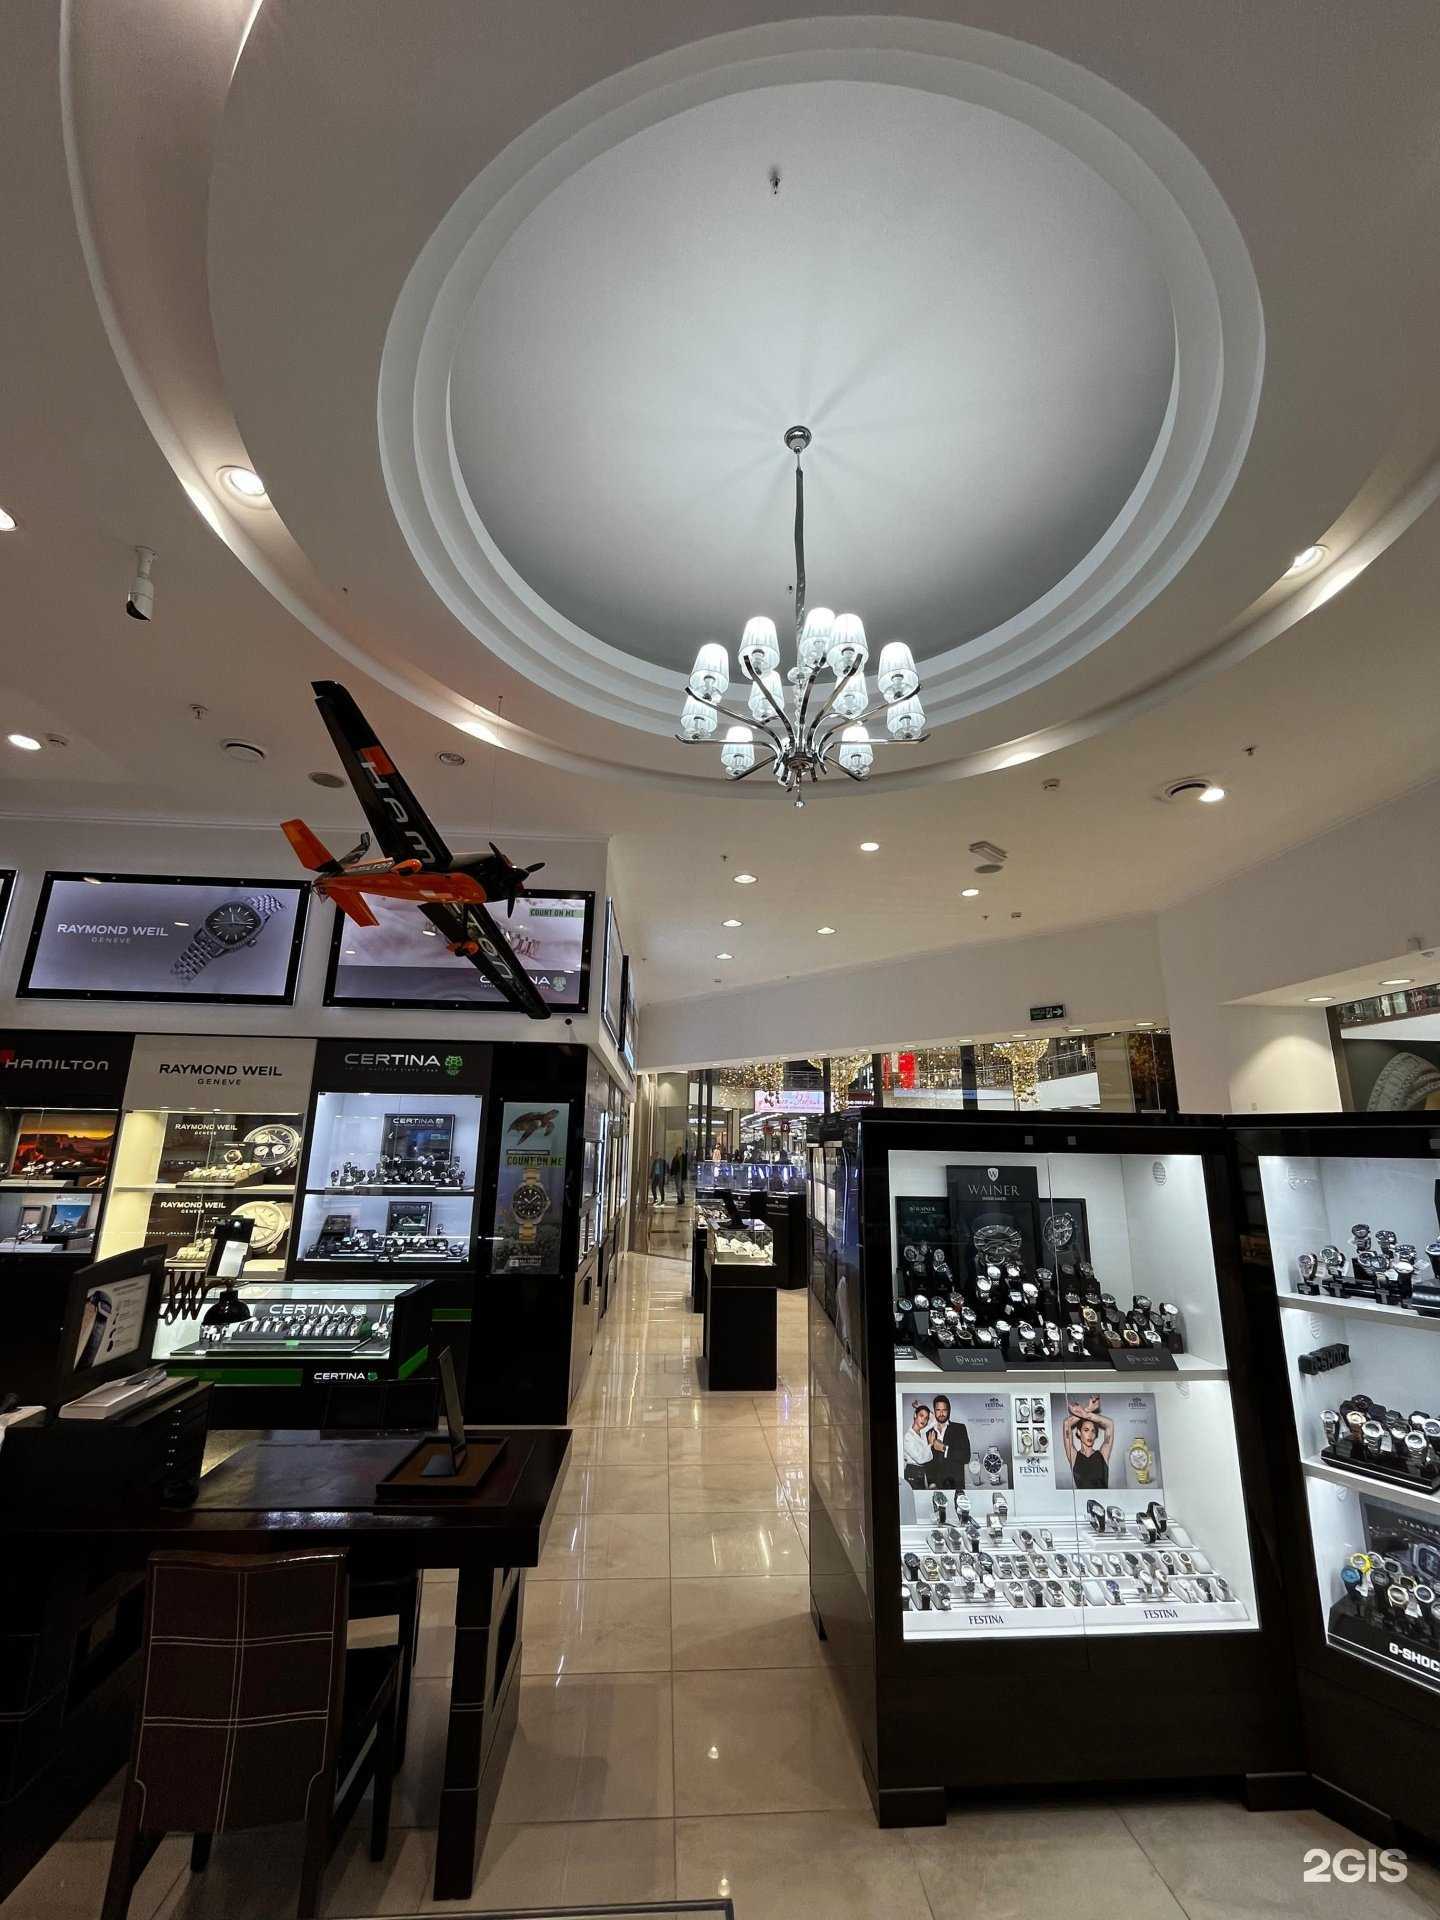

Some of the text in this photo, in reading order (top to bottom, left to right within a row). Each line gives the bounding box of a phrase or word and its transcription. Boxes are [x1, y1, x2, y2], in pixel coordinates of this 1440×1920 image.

[554, 909, 564, 917] ON
[57, 923, 169, 937] RAYMOND WEIL
[4, 1058, 110, 1071] HAMILTON
[344, 1053, 441, 1067] CERTINA
[159, 1063, 283, 1077] RAYMOND WEIL
[197, 1078, 242, 1086] GENEVE
[175, 1123, 215, 1131] RAYMOND
[507, 1156, 537, 1167] COUNT
[551, 1157, 563, 1167] ME
[968, 1184, 1020, 1196] WAINER
[160, 1201, 202, 1209] RAYMOND
[269, 1304, 348, 1315] CERTINA
[313, 1372, 366, 1381] CERTINA
[1019, 1466, 1049, 1474] FESTINA
[1144, 1609, 1179, 1619] FESTINA
[968, 1615, 1004, 1625] FESTINA
